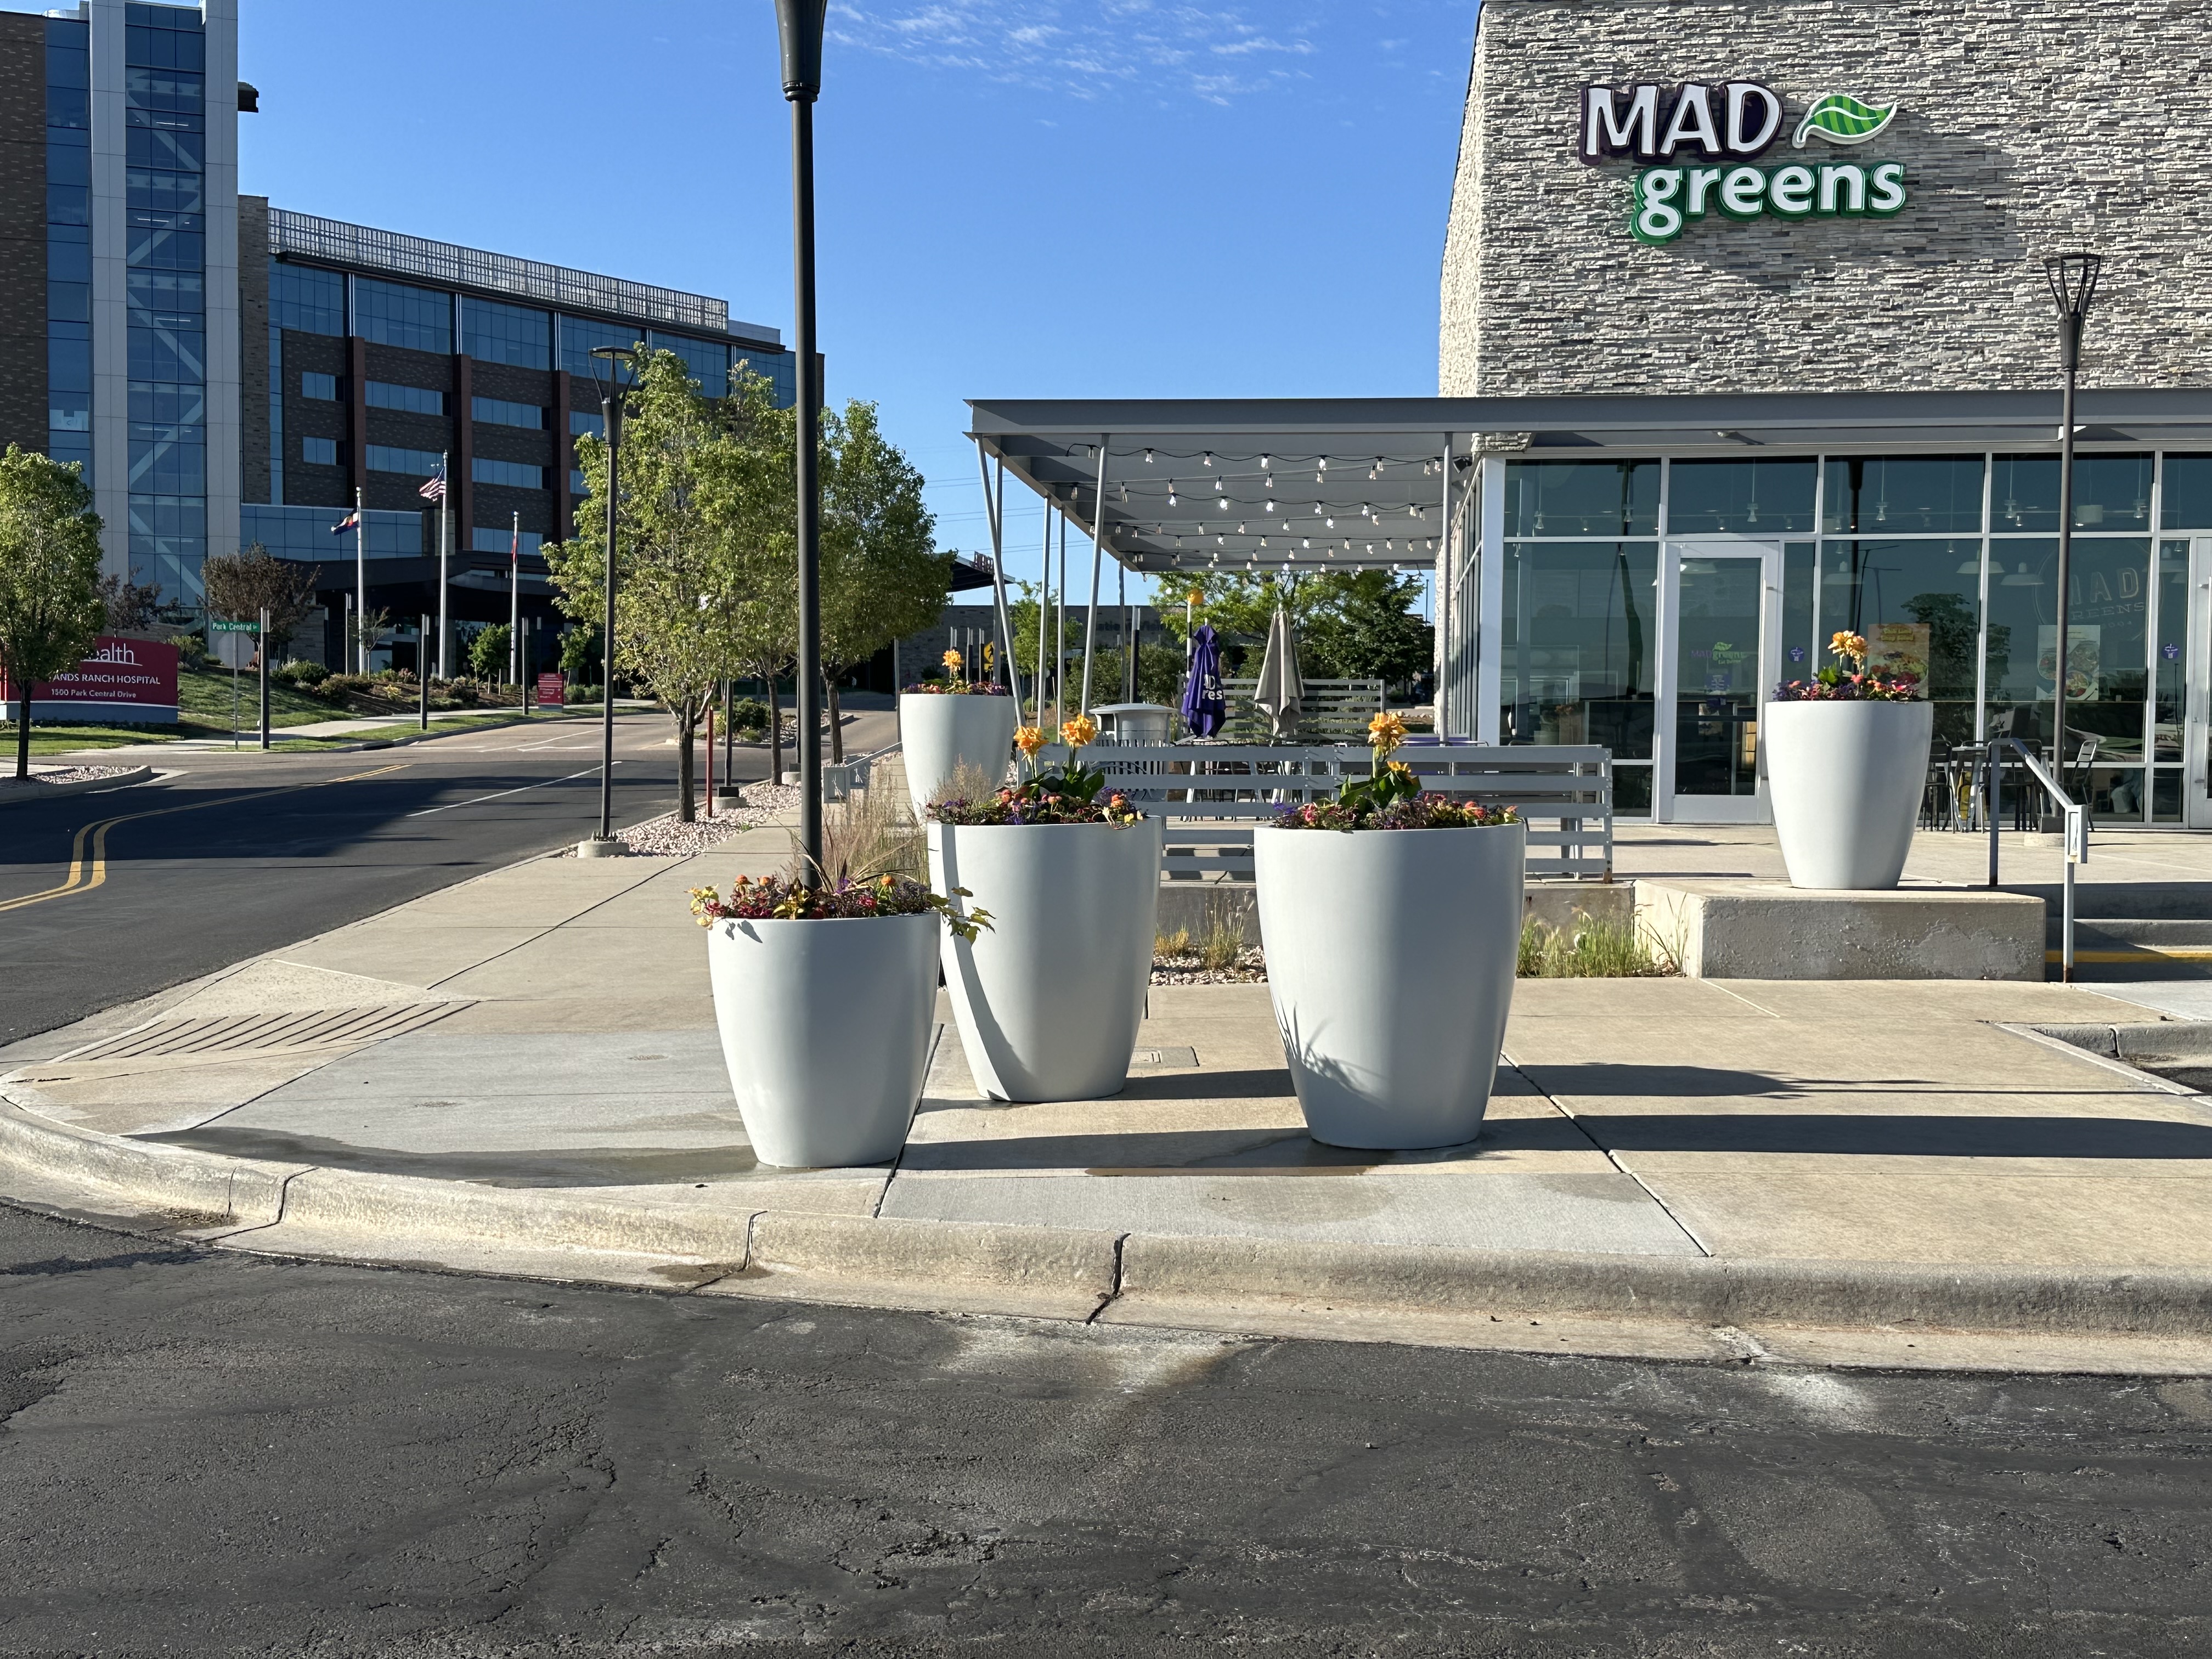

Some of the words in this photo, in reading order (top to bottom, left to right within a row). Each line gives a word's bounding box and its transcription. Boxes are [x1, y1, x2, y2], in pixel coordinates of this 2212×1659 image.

[1581, 81, 1784, 161] MAD
[1634, 162, 1906, 242] greens
[82, 674, 115, 683] RANCH
[117, 675, 161, 685] HOSPITAL
